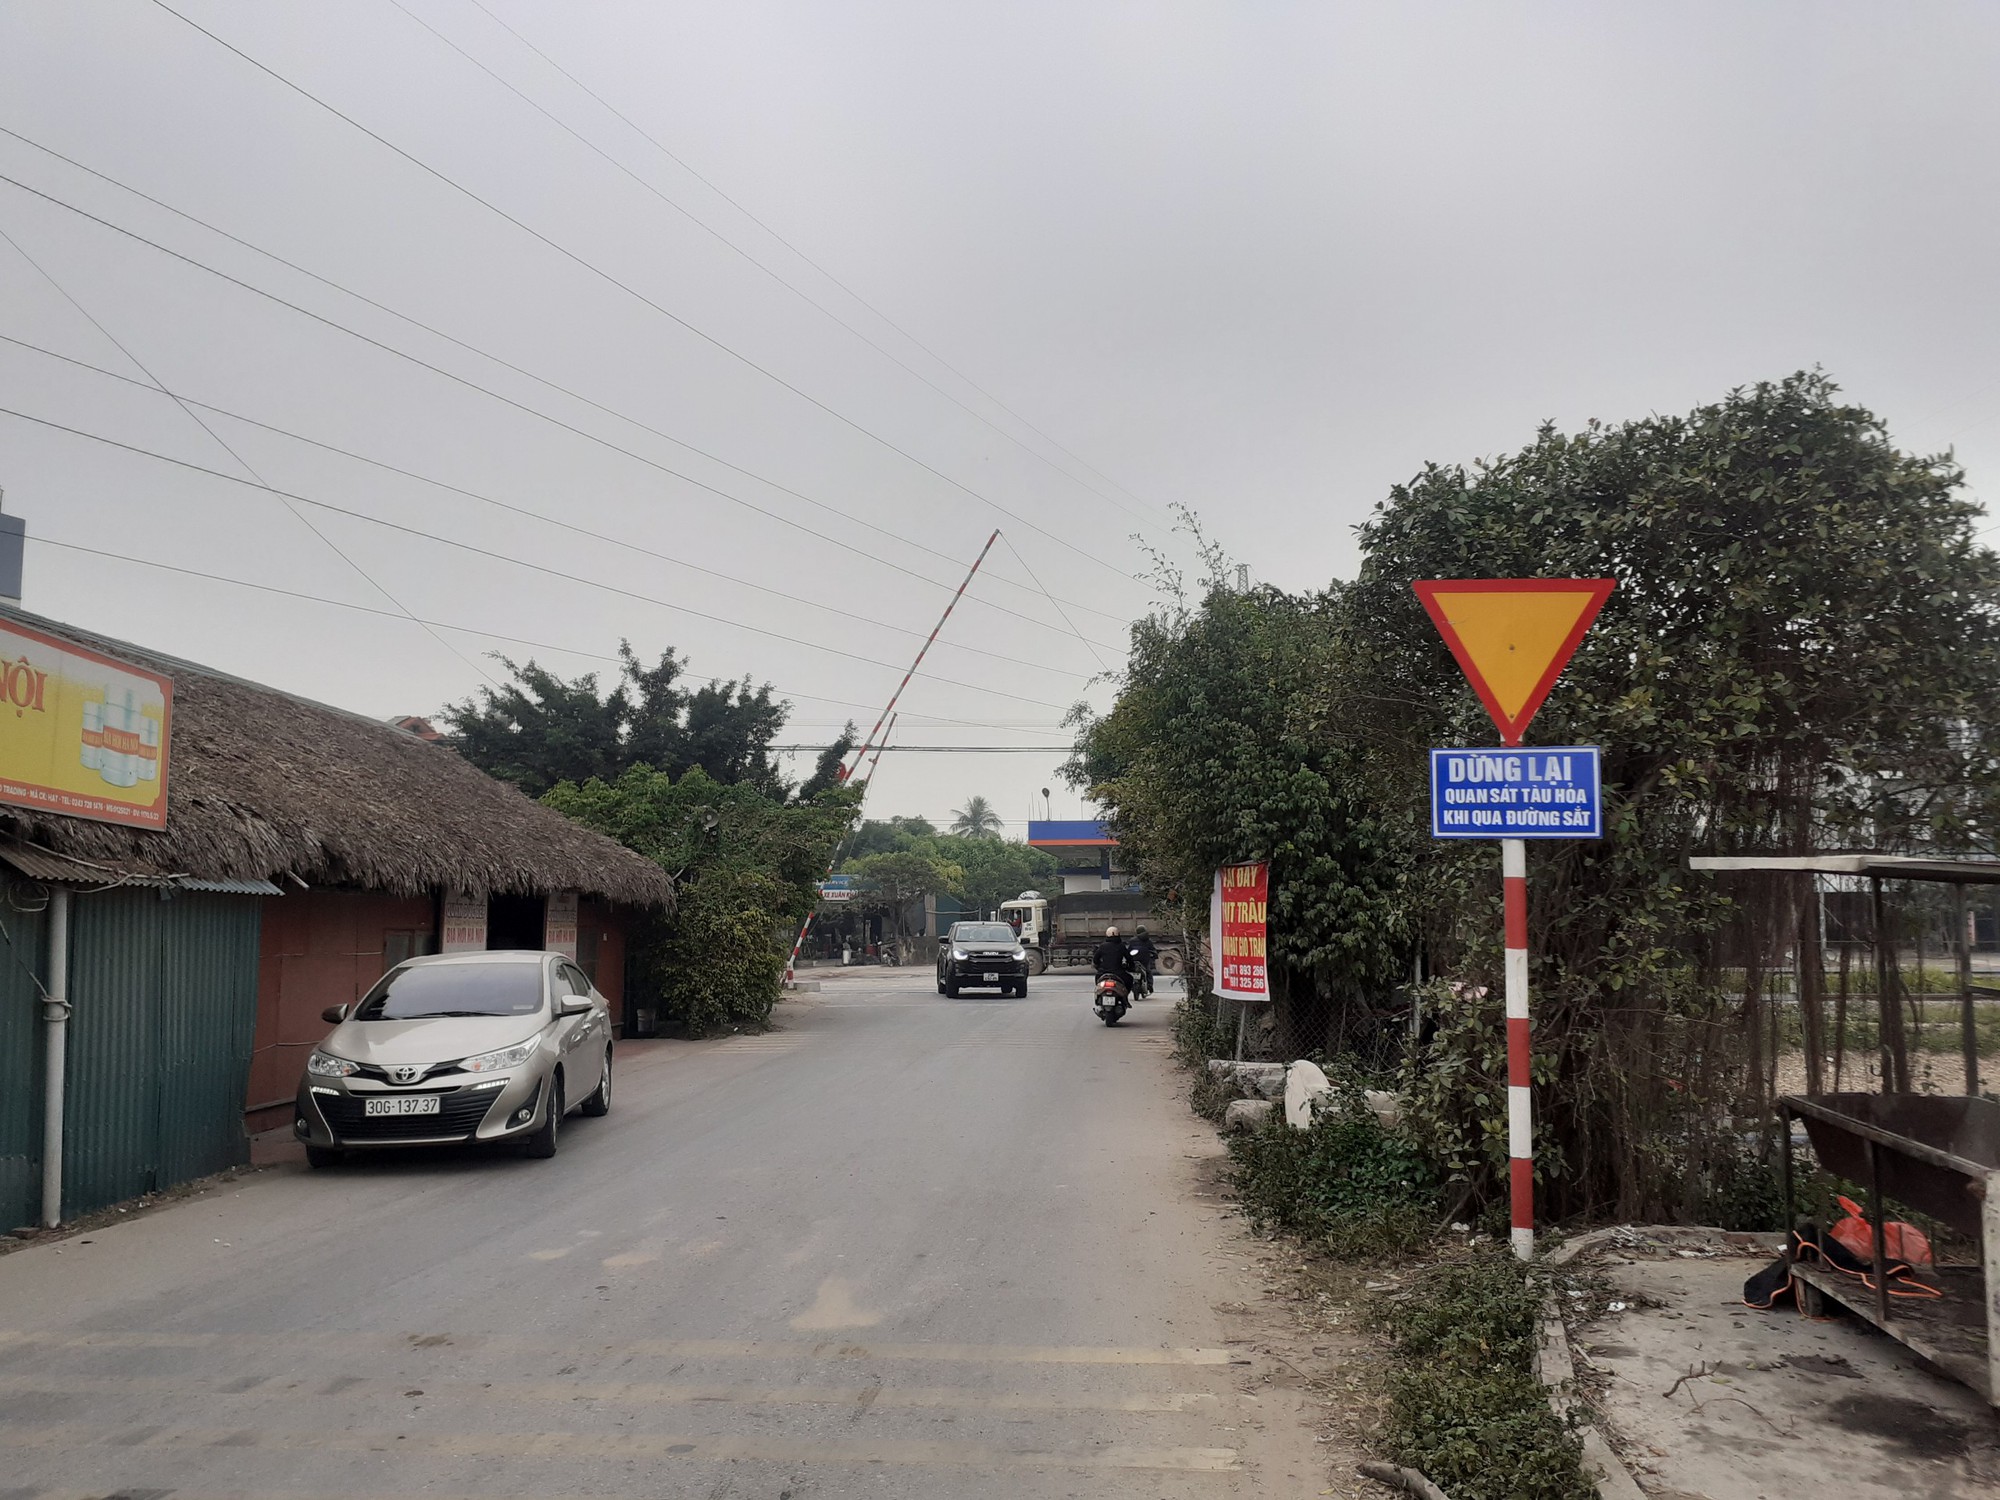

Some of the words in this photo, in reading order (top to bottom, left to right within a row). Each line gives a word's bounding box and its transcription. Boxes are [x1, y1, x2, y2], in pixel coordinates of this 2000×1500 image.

[1448, 754, 1522, 783] DỪNG
[1528, 756, 1572, 785] LẠI
[3, 785, 27, 797] TRADING
[1445, 788, 1488, 805] QUAN
[1489, 784, 1519, 804] SÁT
[1520, 785, 1551, 804] TÀU
[1554, 783, 1588, 804] HỎA
[1443, 809, 1470, 825] KHI
[1472, 810, 1503, 827] QUA
[1505, 806, 1560, 827] ĐƯỜNG
[1562, 805, 1591, 827] SẮT
[1237, 897, 1267, 924] TRÂU
[1239, 965, 1252, 976] 893
[1239, 977, 1252, 988] 325
[367, 1098, 438, 1115] 30G-137.37
